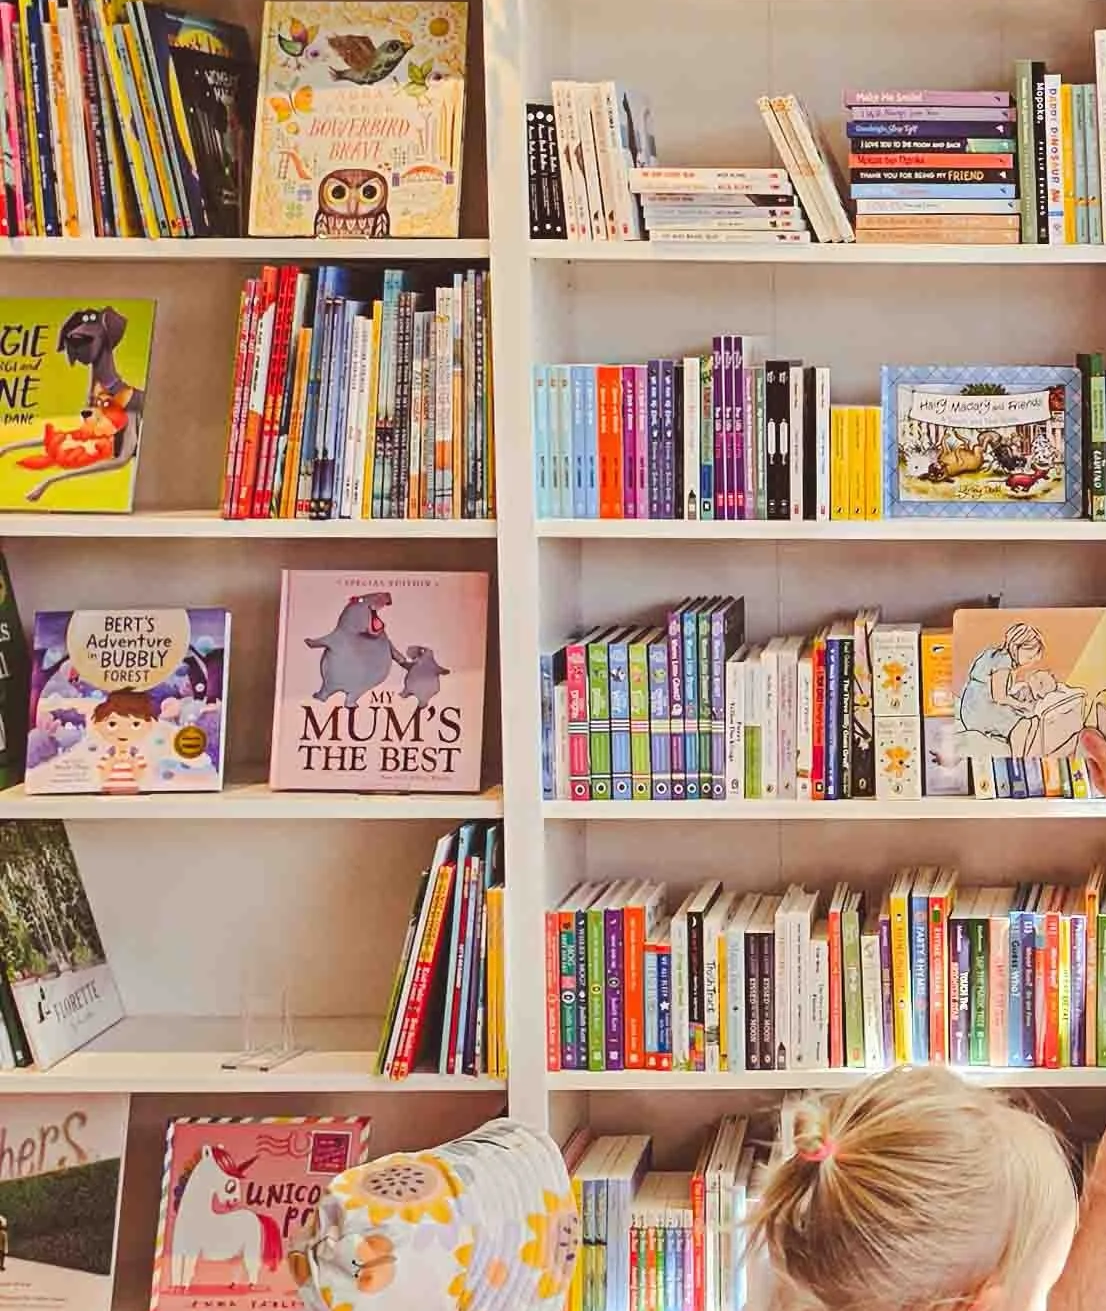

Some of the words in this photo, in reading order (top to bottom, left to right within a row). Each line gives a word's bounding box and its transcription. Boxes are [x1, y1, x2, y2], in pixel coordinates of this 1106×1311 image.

[310, 117, 411, 137] BOWERBIRD
[329, 140, 383, 160] BRAVE
[1050, 127, 1059, 183] DINOSAUR
[947, 170, 984, 181] FRIEND
[920, 398, 947, 415] Hairy
[1008, 399, 1041, 411] Friends
[104, 615, 156, 633] BERT'S
[86, 634, 172, 649] Adventure
[100, 649, 169, 668] BUBBLY
[103, 669, 151, 682] FOREST
[370, 691, 395, 705] MY
[300, 704, 463, 744] MUM'S
[298, 745, 367, 771] THE
[379, 746, 462, 774] BEST
[915, 926, 925, 956] PARTY
[1011, 940, 1019, 968] Guess
[959, 971, 969, 995] TOUCH
[959, 997, 968, 1011] THE
[246, 1181, 322, 1207] UNICO
